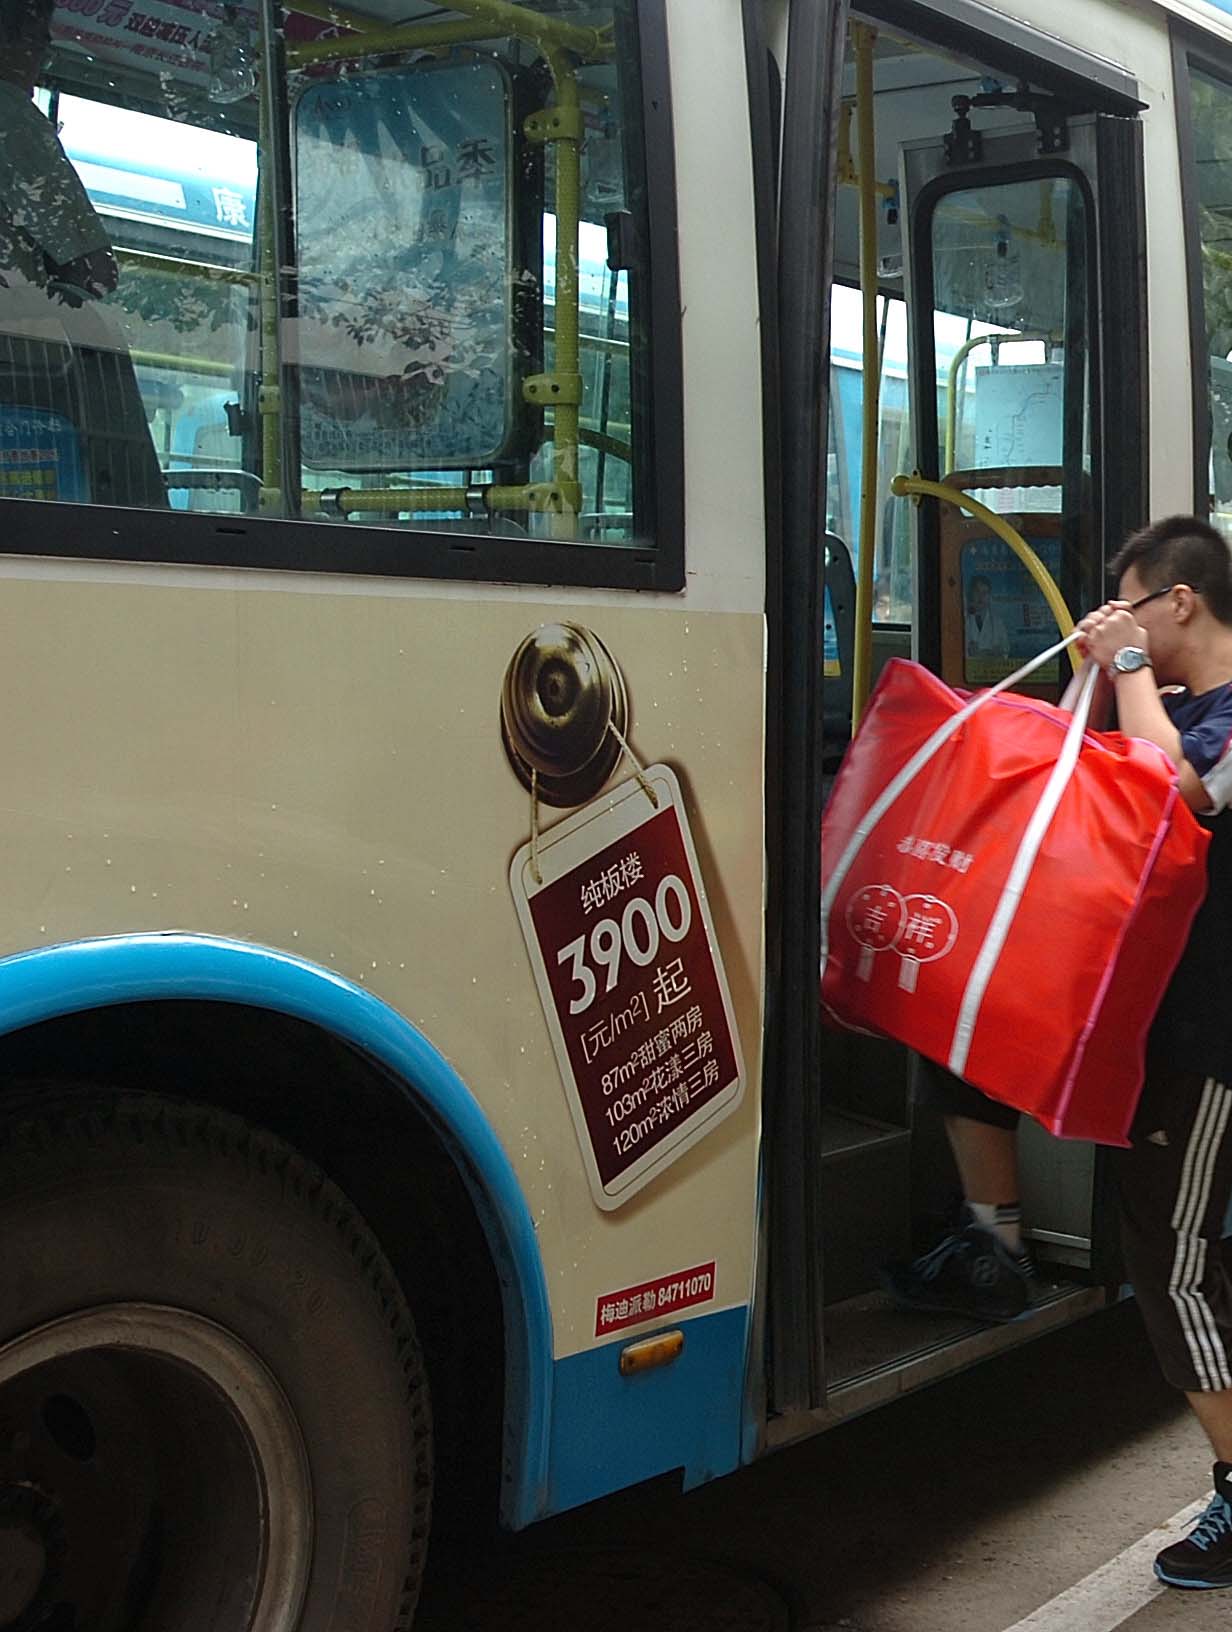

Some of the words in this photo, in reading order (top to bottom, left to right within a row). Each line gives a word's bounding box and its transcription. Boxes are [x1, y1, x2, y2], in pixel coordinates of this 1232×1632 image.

[211, 187, 250, 228] 康
[580, 852, 645, 915] 纯板楼
[557, 874, 692, 1015] 3900
[652, 957, 692, 1014] 起
[657, 1272, 712, 1307] 84711070
